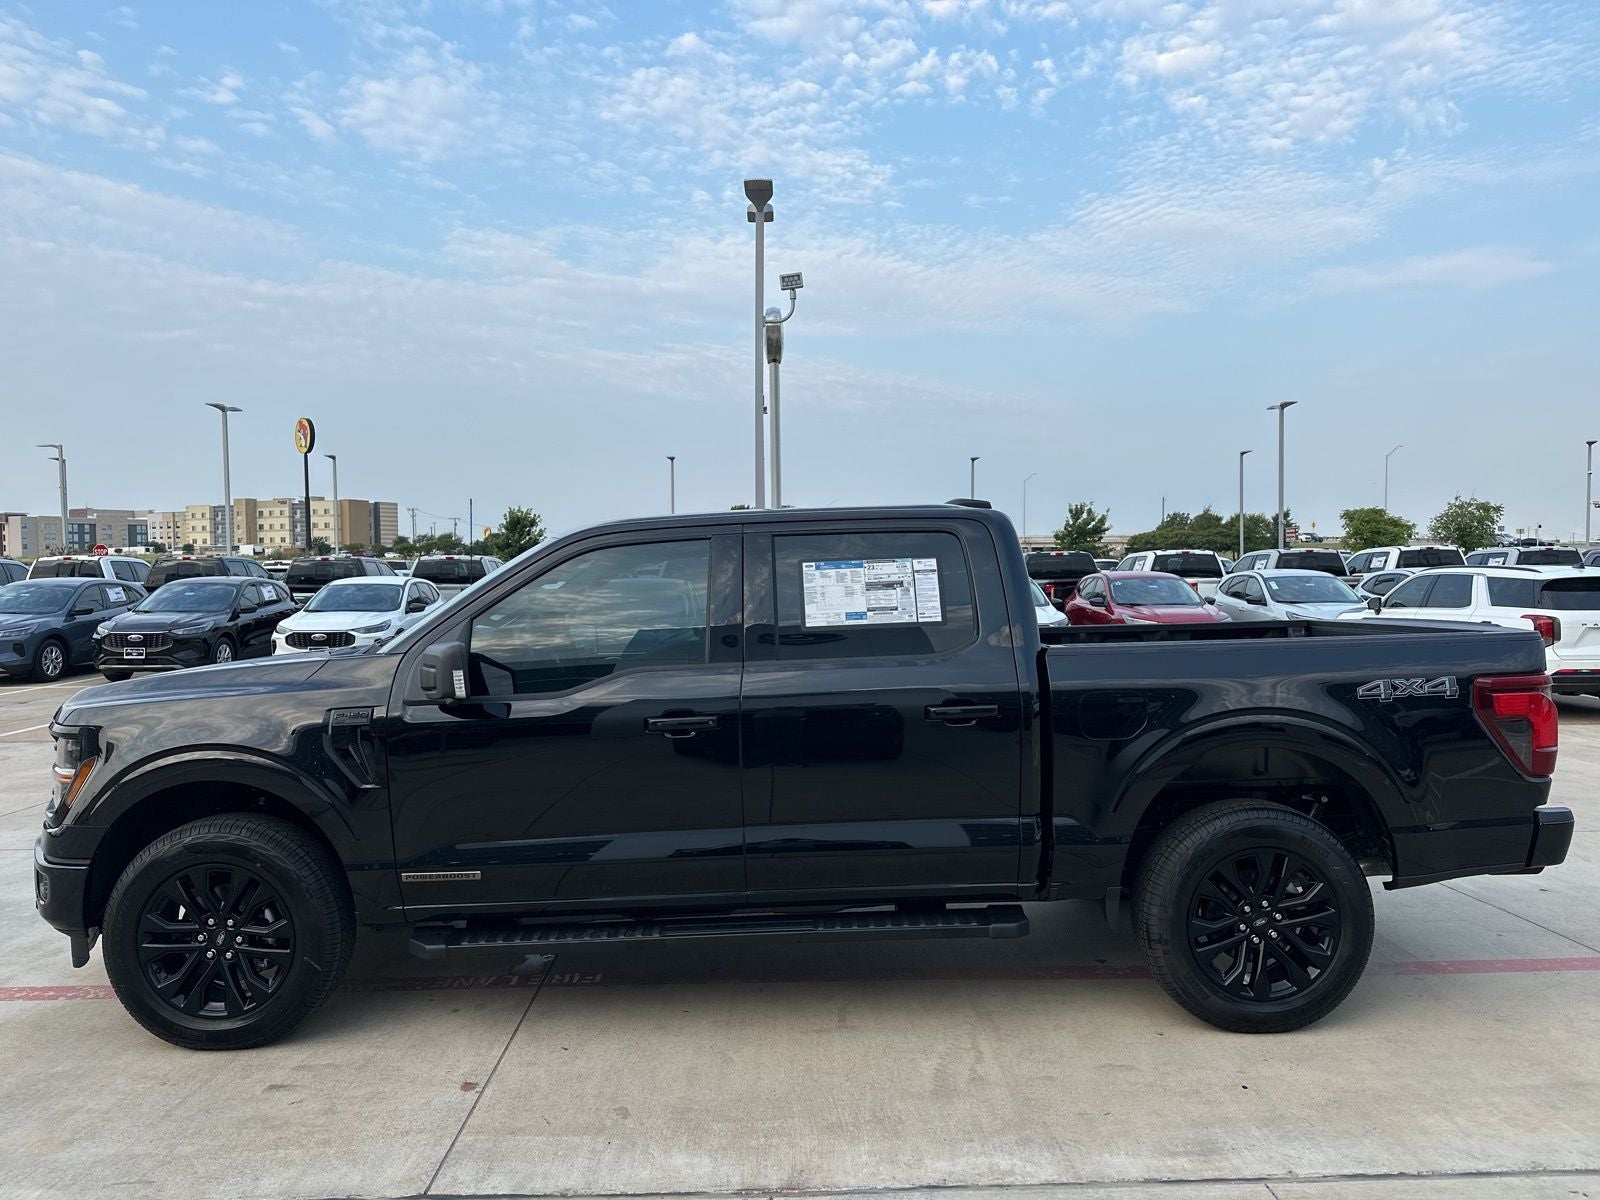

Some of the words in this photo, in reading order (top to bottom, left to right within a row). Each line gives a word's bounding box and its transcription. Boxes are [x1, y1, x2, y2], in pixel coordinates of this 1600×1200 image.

[94, 548, 108, 556] STOP
[404, 872, 477, 881] POWERBOOST
[528, 972, 602, 985] FIRE
